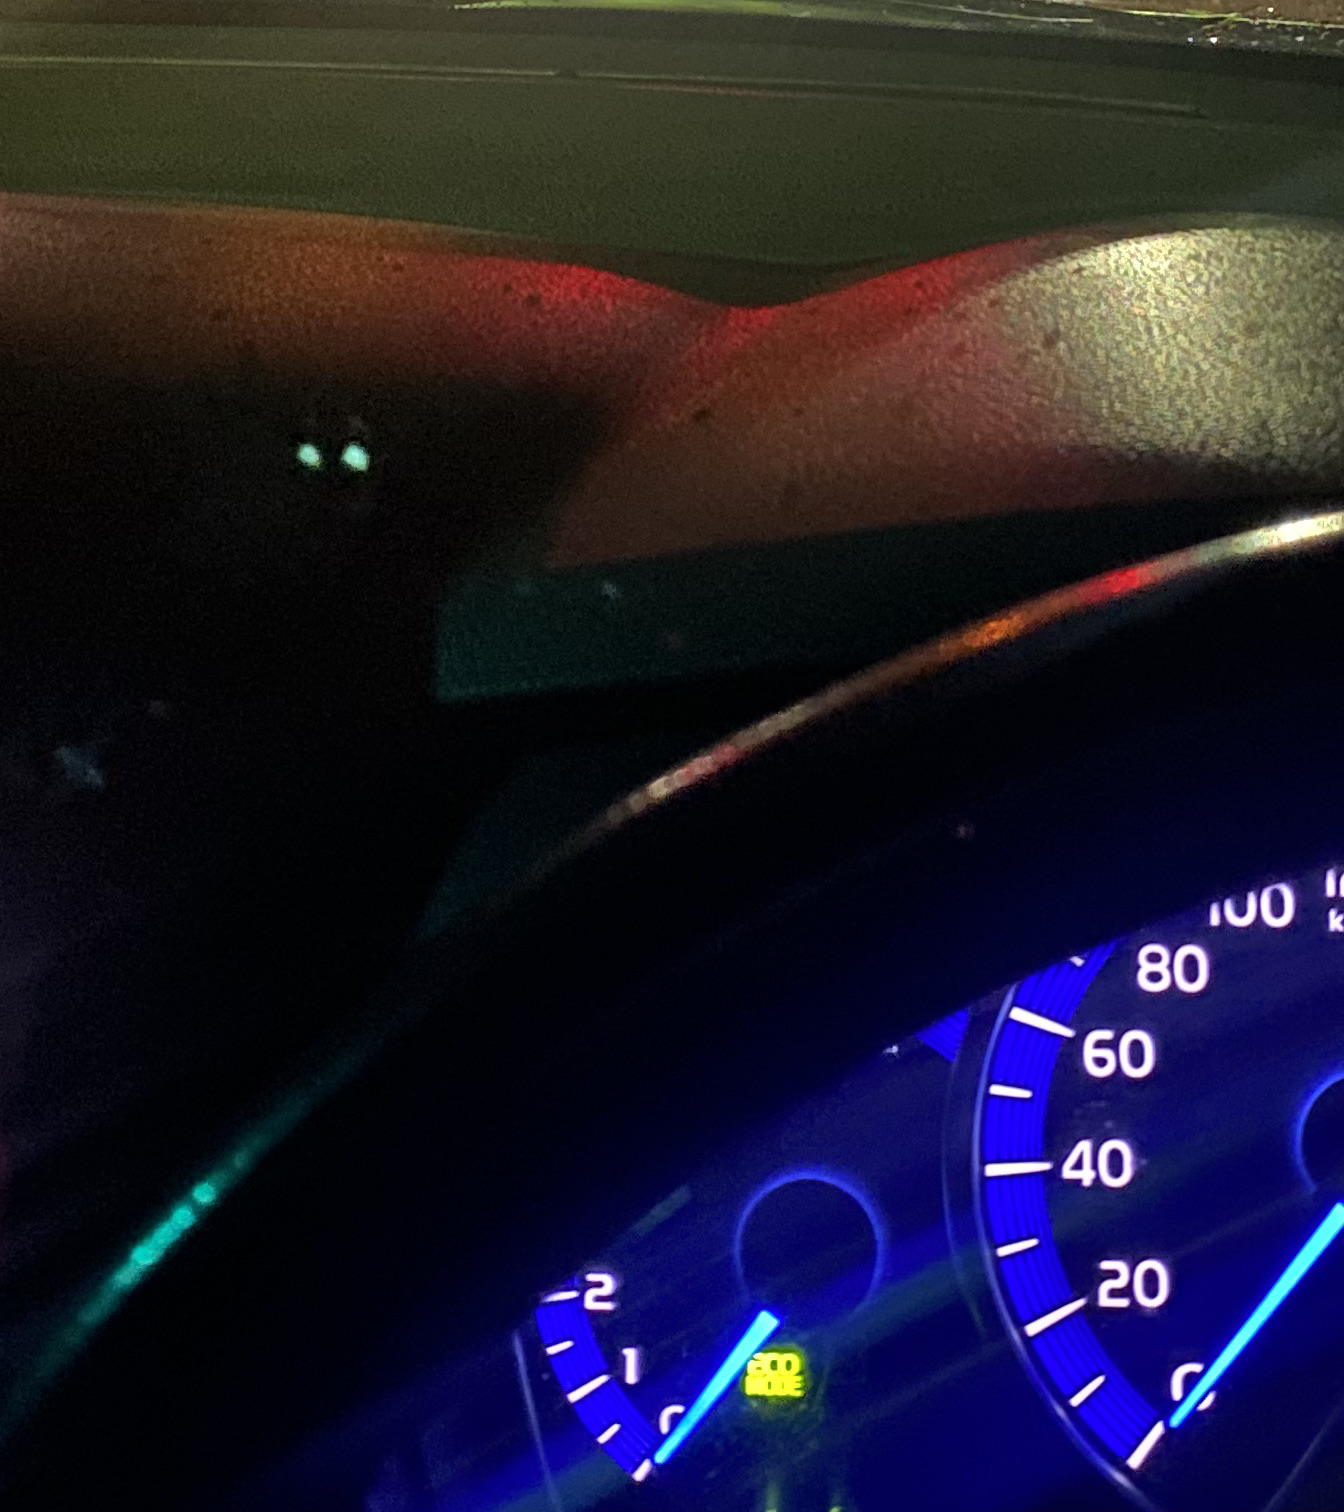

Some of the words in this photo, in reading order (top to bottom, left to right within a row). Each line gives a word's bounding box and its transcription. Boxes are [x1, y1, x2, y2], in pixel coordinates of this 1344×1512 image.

[1210, 884, 1294, 927] 100
[1138, 944, 1208, 992] 80
[1084, 1030, 1154, 1077] 60
[1062, 1140, 1133, 1187] 40
[584, 1274, 615, 1310] 2
[1099, 1260, 1168, 1307] 20
[622, 1348, 637, 1384] 1
